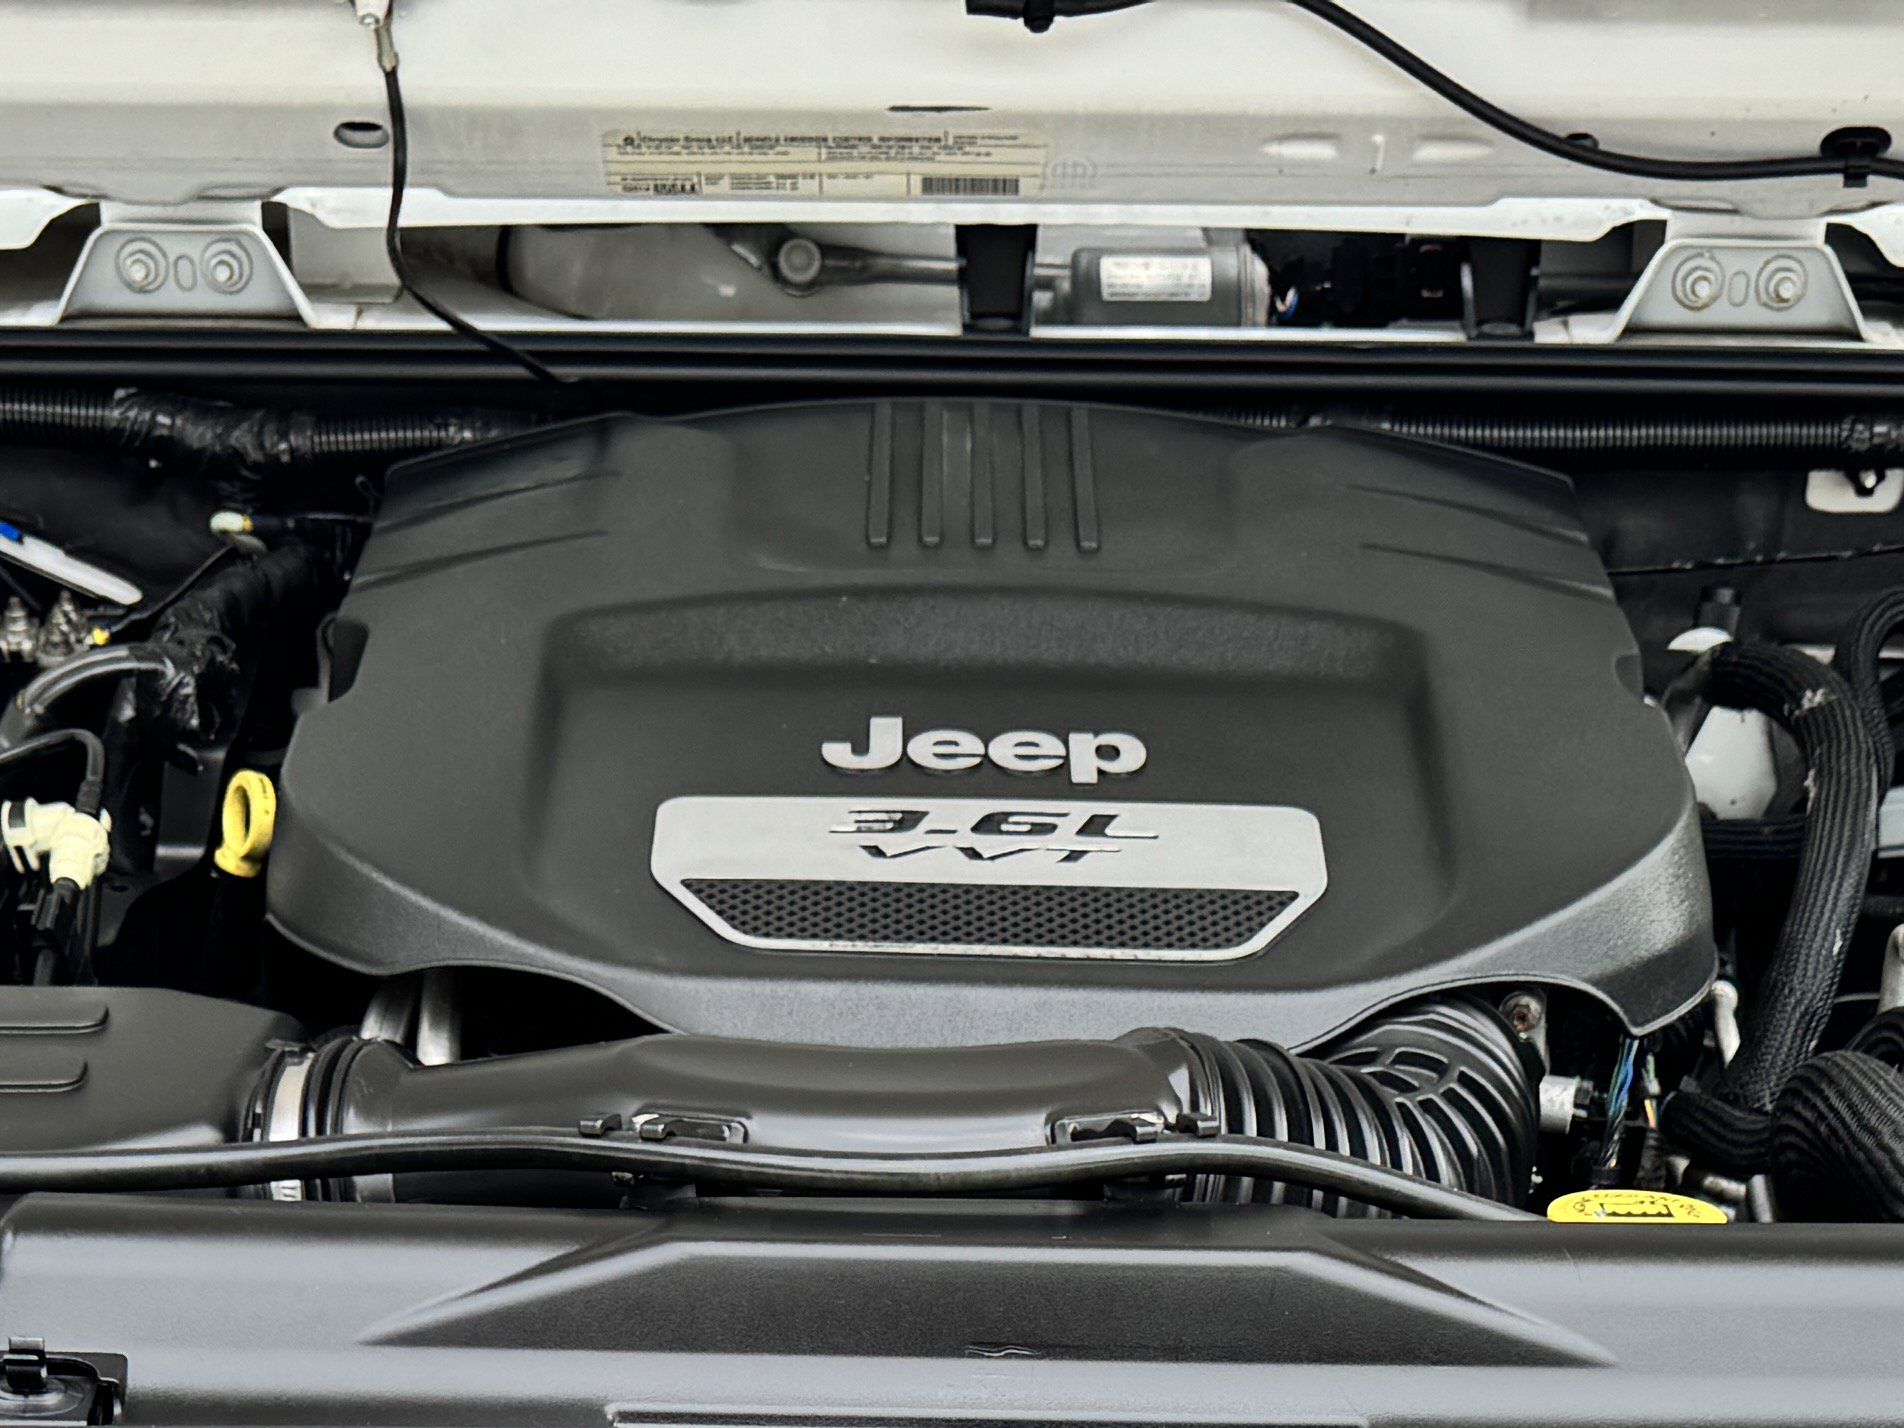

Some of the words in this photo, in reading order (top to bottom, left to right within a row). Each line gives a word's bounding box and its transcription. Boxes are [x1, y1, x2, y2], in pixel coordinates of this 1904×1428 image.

[821, 716, 1147, 784] Jeep
[828, 809, 1160, 840] 3.6L
[858, 844, 1123, 864] VVT
